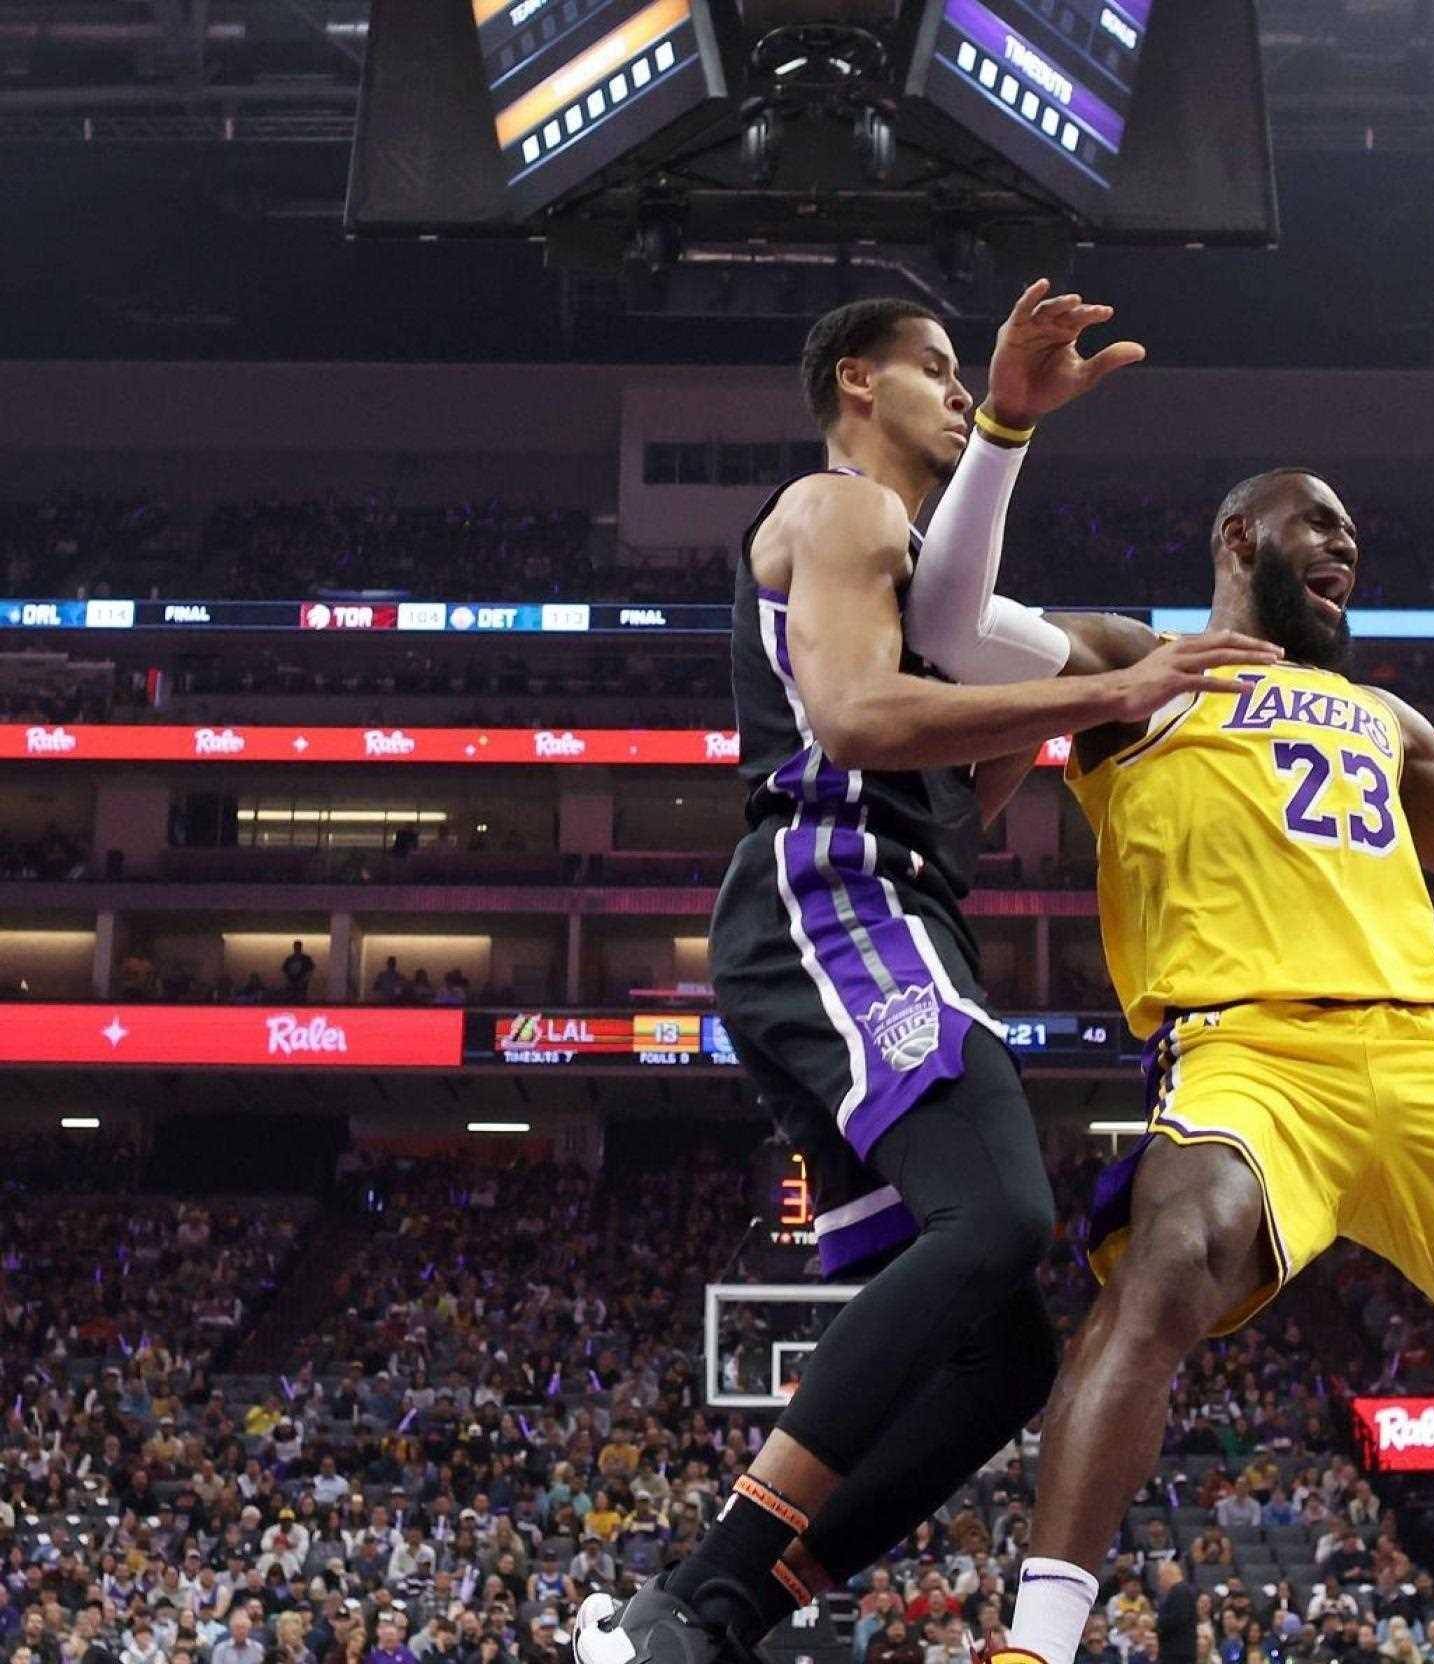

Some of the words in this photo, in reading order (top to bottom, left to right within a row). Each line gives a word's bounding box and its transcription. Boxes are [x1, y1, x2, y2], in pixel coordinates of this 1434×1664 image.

[164, 605, 211, 622] FINAL
[333, 606, 374, 629] TOR
[477, 608, 518, 629] DET
[619, 609, 666, 625] FINAL
[1221, 673, 1393, 759] LAKERS
[1271, 738, 1397, 856] 23
[548, 1019, 594, 1043] LAL
[655, 1023, 680, 1044] 13
